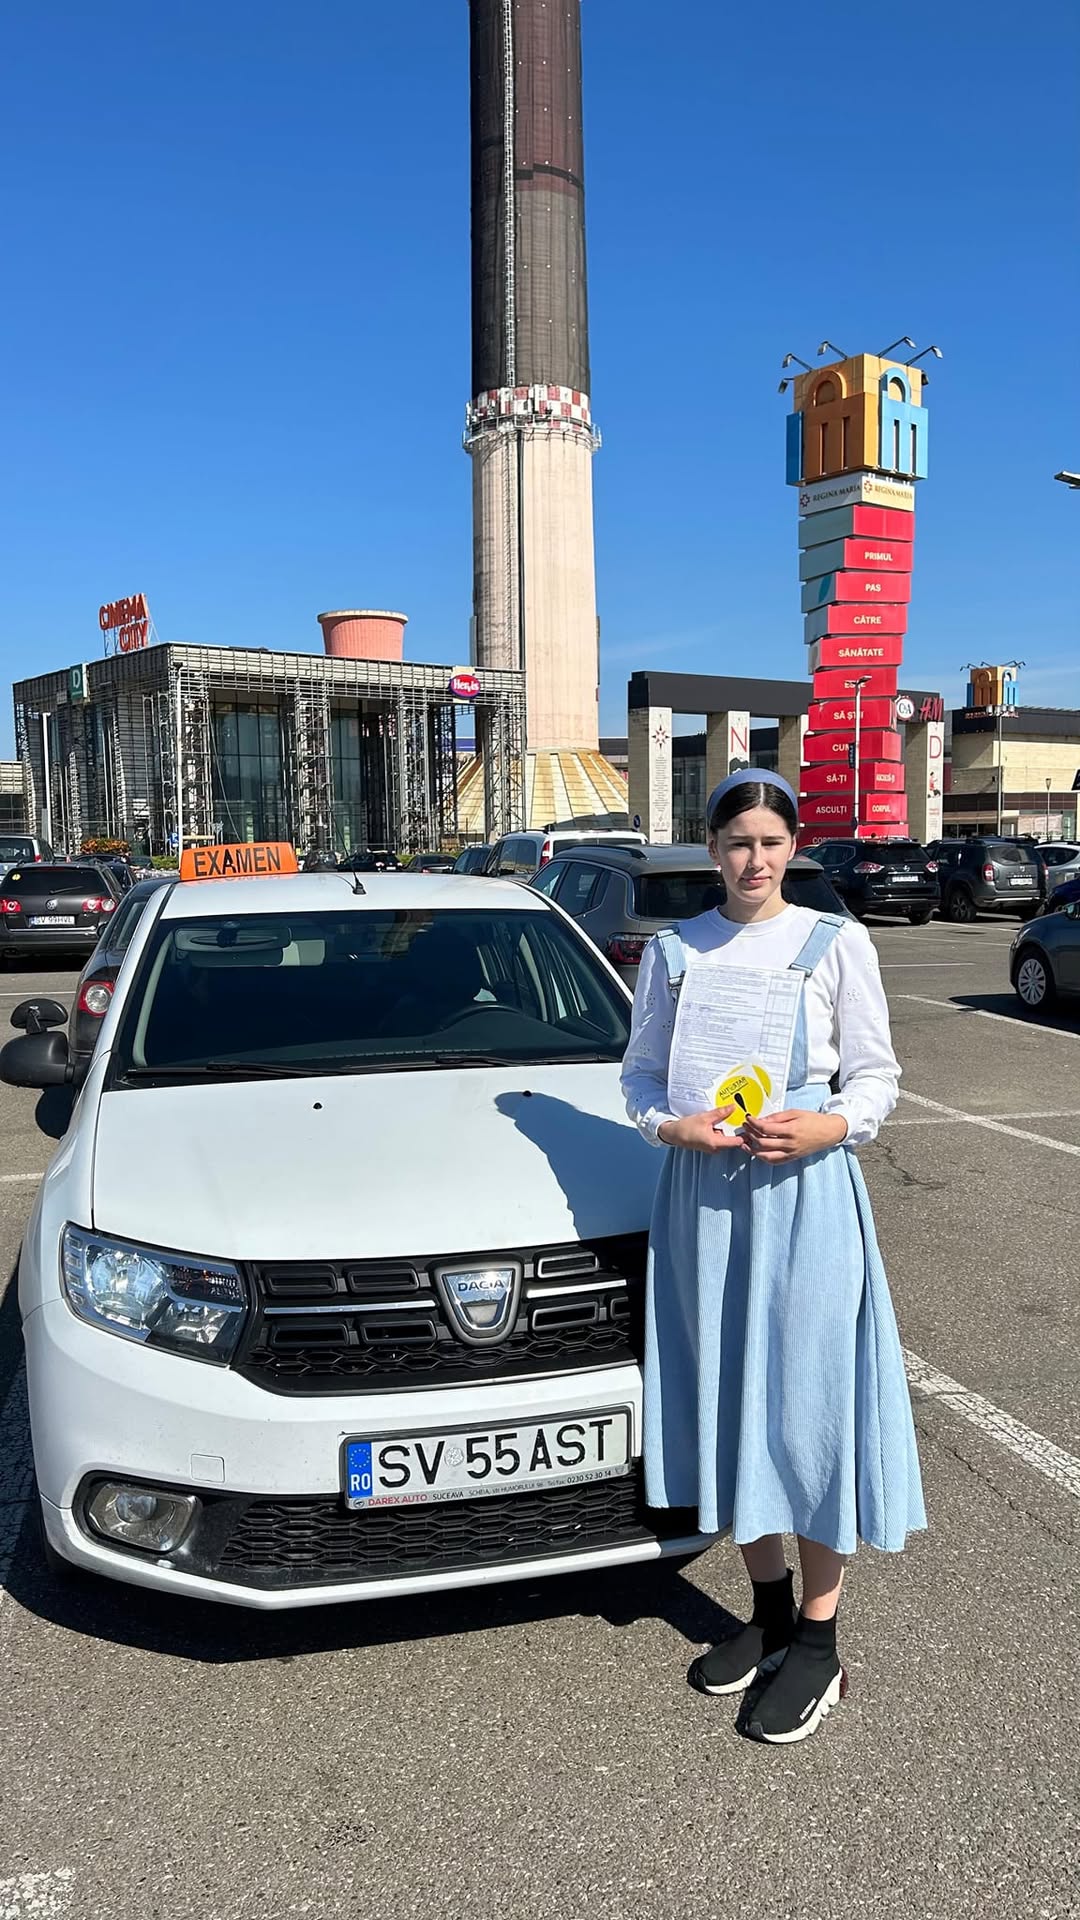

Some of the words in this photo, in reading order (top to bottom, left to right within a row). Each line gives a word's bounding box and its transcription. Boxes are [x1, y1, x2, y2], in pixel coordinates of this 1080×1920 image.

[864, 551, 893, 562] PRIMUL
[865, 583, 881, 592] PAS
[853, 615, 882, 624] CĂTRE
[838, 647, 884, 657] SĂNĂTATE
[833, 710, 846, 720] SĂ
[730, 726, 747, 753] N
[929, 735, 942, 758] D
[193, 846, 281, 877] EXAMEN
[457, 1280, 504, 1292] DACIA
[378, 1440, 446, 1488] SV
[350, 1473, 371, 1491] RO
[368, 1496, 401, 1507] DAREX
[402, 1494, 428, 1503] AUTO
[432, 1491, 464, 1501] SUCEAVA
